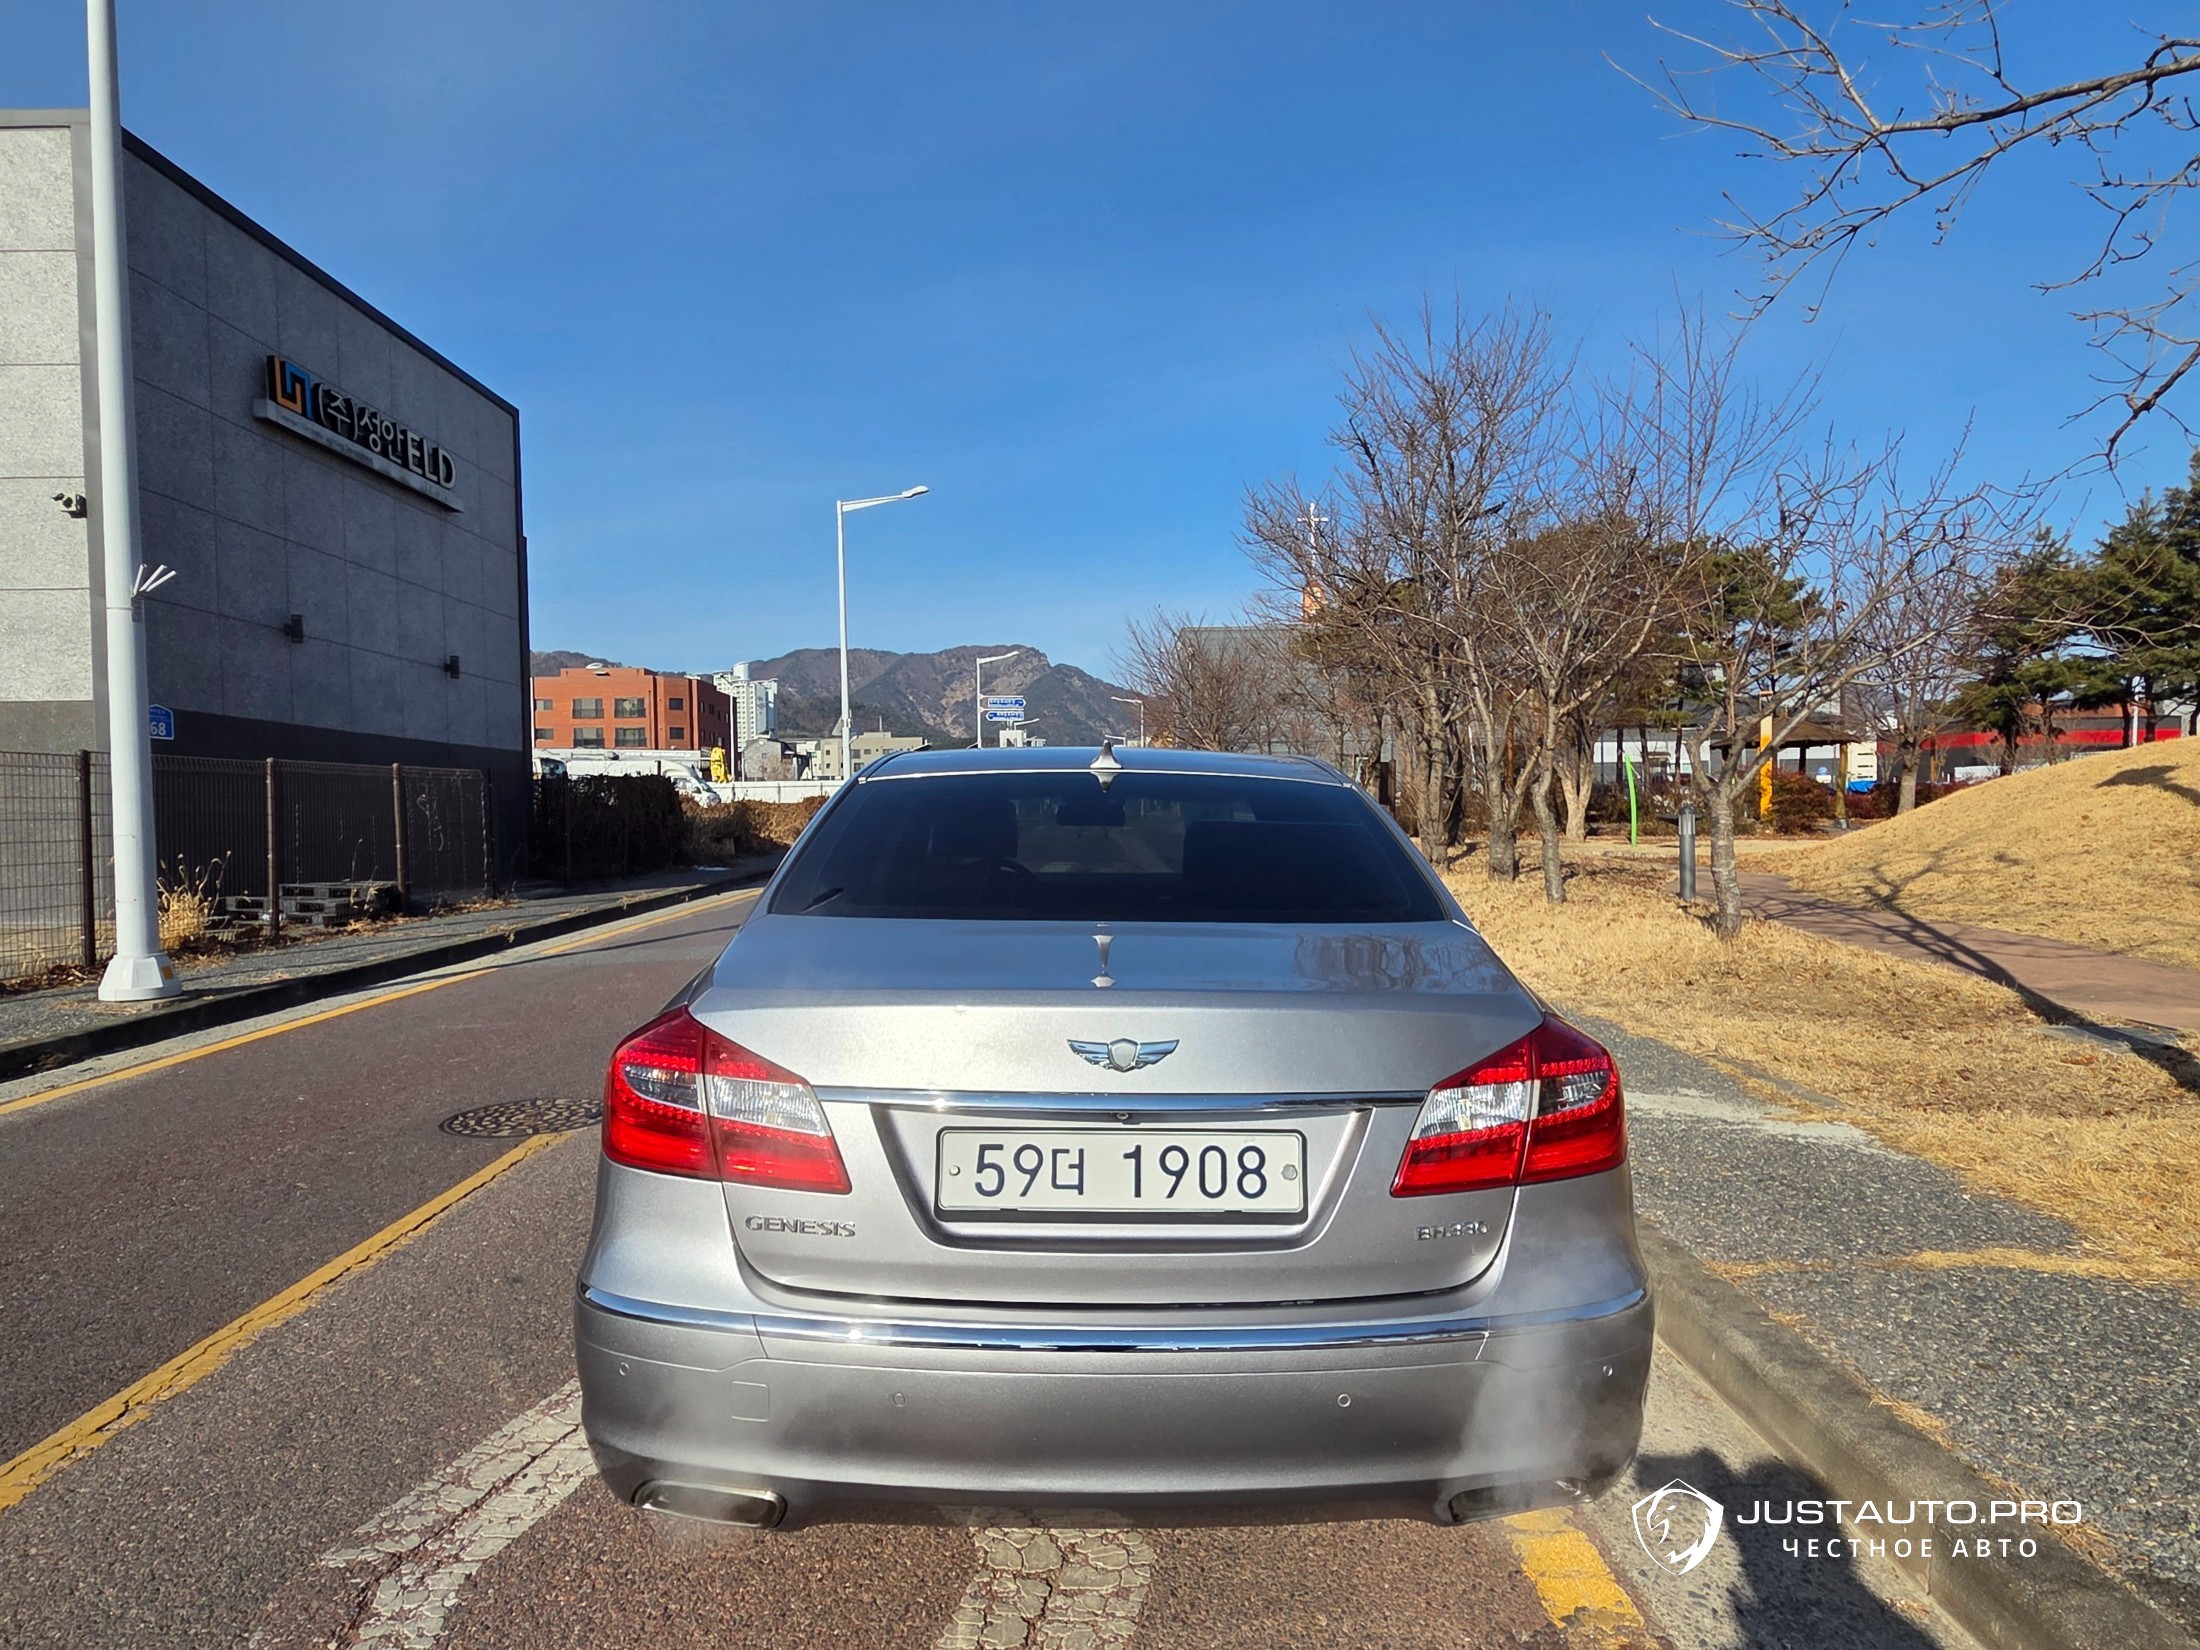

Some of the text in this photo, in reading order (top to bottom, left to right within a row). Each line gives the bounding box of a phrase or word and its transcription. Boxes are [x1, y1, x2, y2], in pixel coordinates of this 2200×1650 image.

[150, 721, 167, 736] 68
[974, 1143, 1268, 1200] 59더 1908
[745, 1215, 856, 1238] GENESIS
